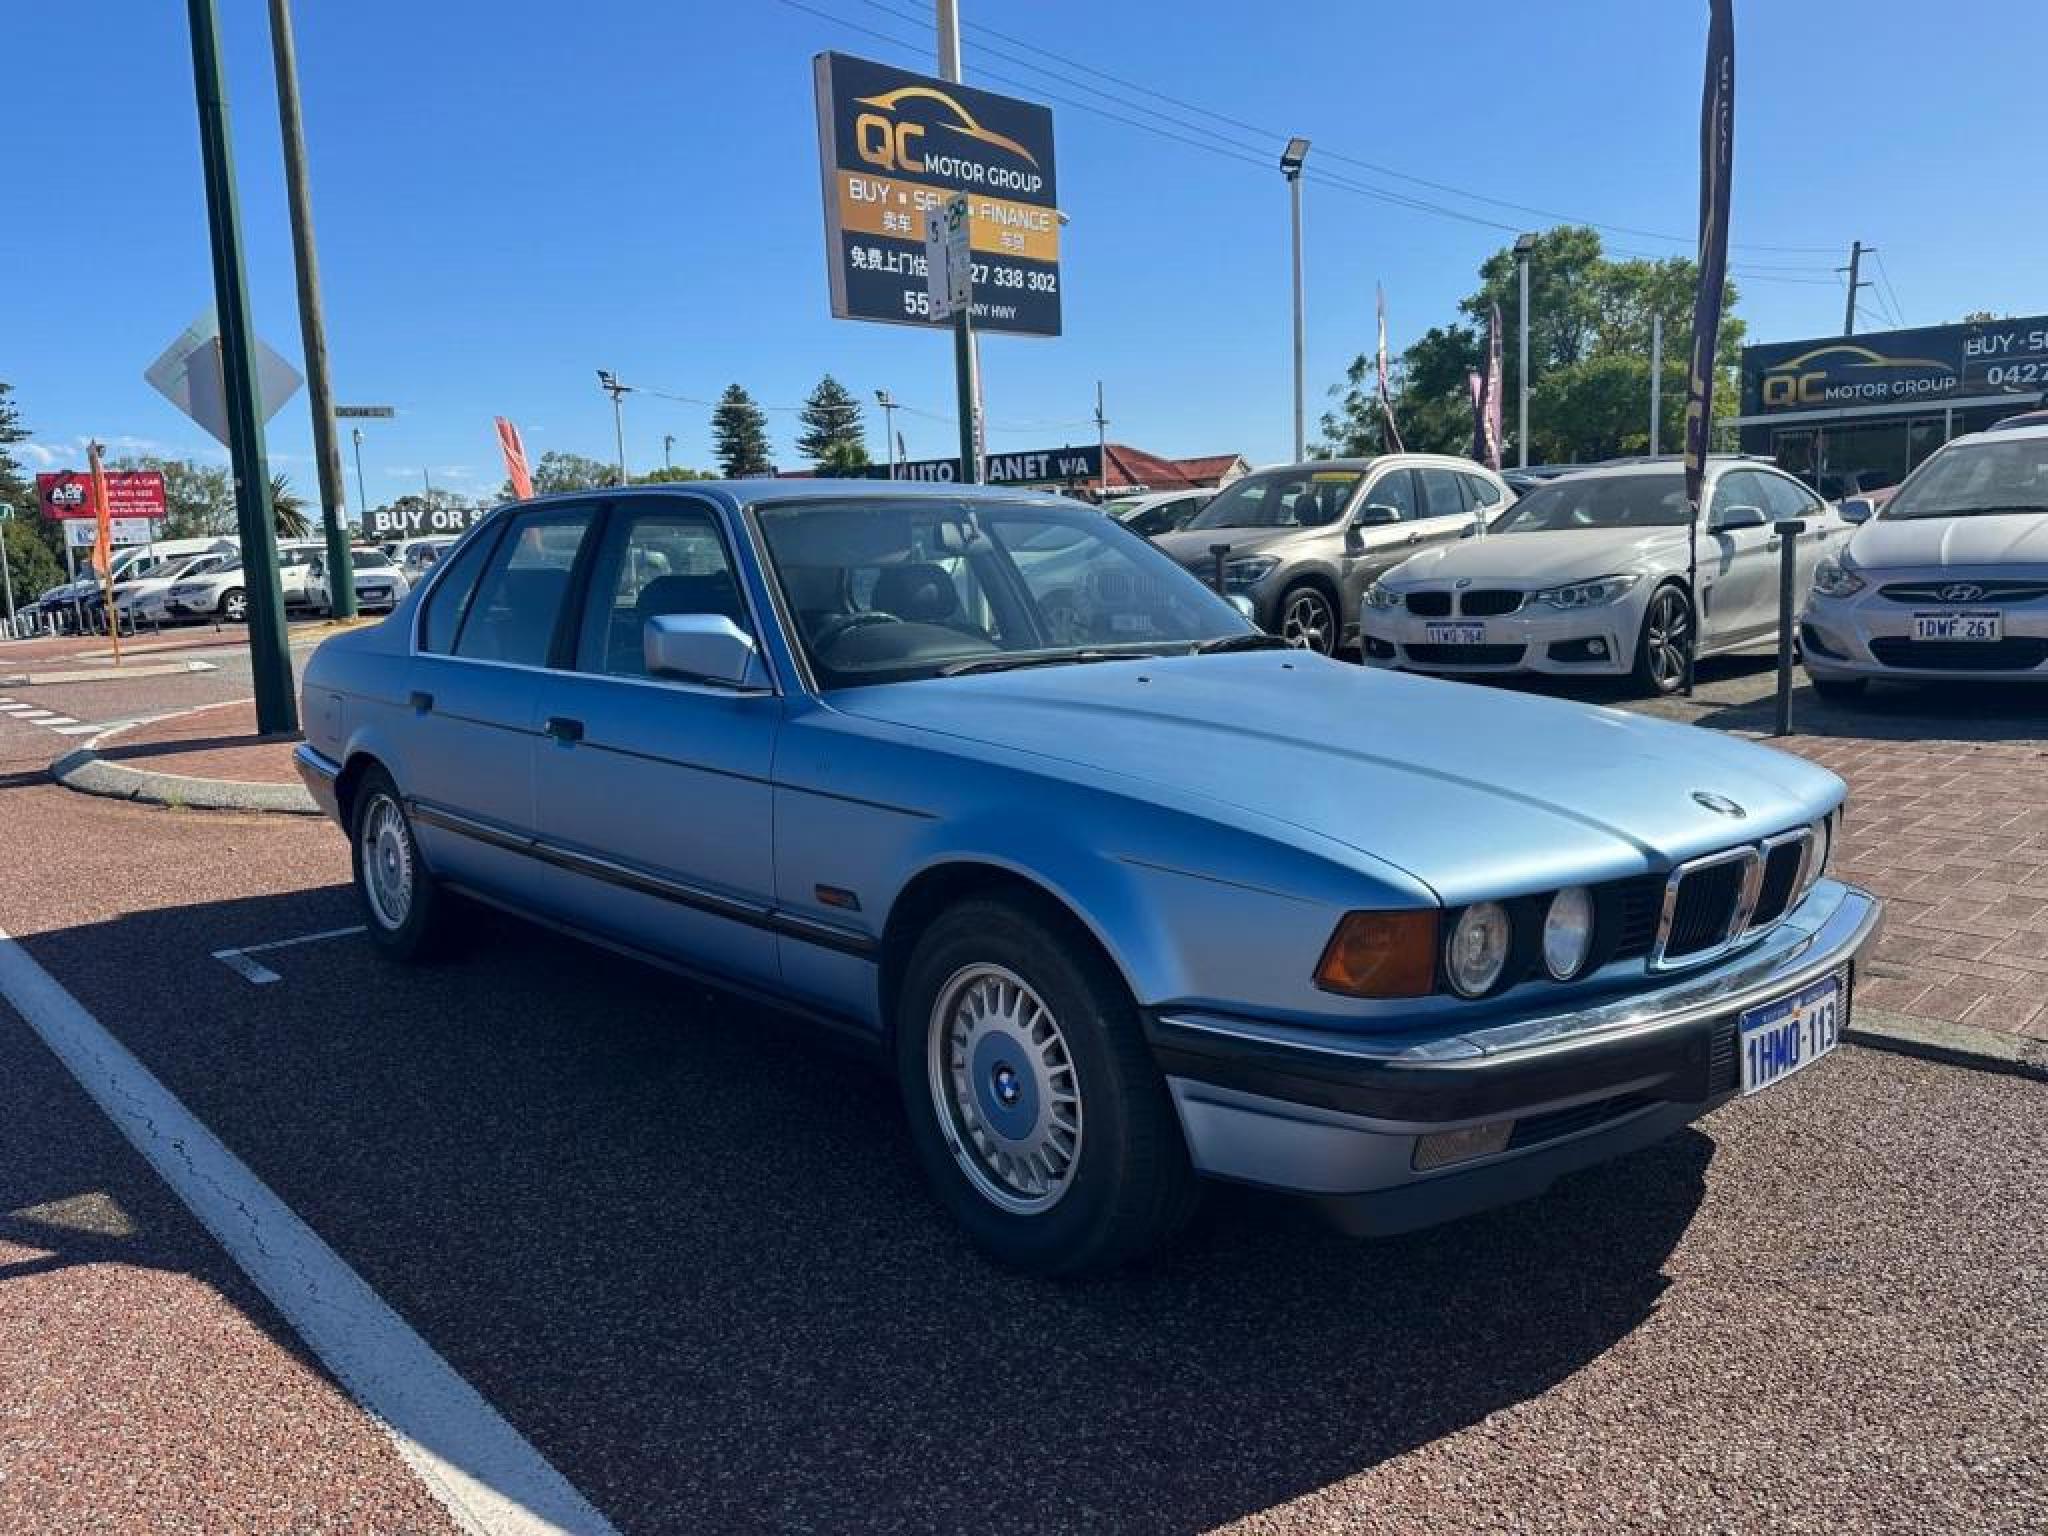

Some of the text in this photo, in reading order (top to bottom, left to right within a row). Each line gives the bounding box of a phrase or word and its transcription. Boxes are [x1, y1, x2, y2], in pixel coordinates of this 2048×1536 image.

[856, 113, 1043, 194] QC MOTOR GROUP
[848, 176, 891, 205] BUY
[981, 203, 1051, 233] FINANCE
[993, 267, 1024, 289] 338
[1027, 271, 1057, 293] 302
[991, 303, 1017, 320] HWY
[1967, 333, 2016, 357] BUY
[1826, 382, 1887, 400] MOTOR
[1891, 376, 1957, 396] GROUP
[375, 511, 423, 531] BUY
[431, 510, 465, 530] OR
